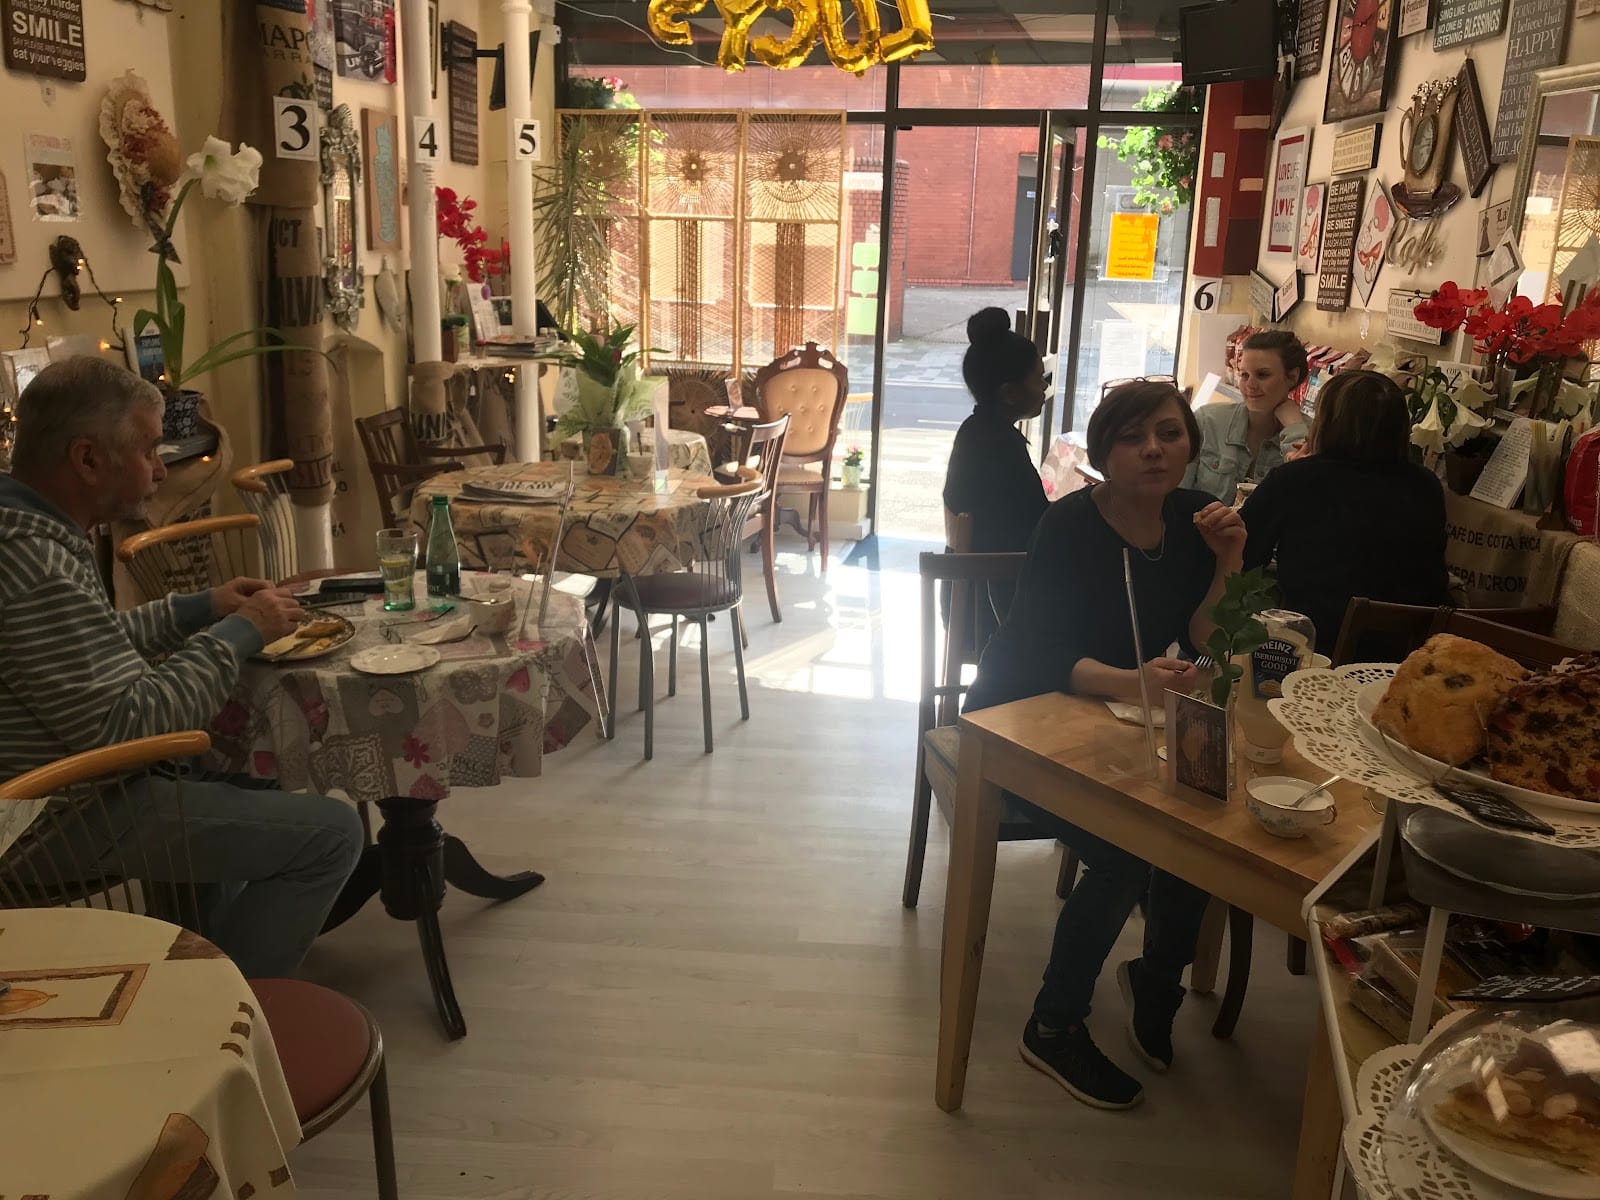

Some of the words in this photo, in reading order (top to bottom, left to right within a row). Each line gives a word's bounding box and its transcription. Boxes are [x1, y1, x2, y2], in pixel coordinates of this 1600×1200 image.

[1439, 8, 1453, 21] SING
[1454, 4, 1466, 17] LIKE
[12, 10, 82, 47] SMILE
[1463, 8, 1501, 39] BLESSINGS
[1297, 38, 1320, 56] SMILE
[1433, 30, 1464, 48] LISTENING
[1508, 27, 1561, 59] HAPPY
[13, 48, 28, 60] eat
[280, 105, 310, 151] 3
[418, 122, 438, 157] 4
[519, 124, 536, 155] 5
[1330, 185, 1339, 196] BE
[1339, 180, 1360, 195] HAPPY
[1327, 220, 1335, 230] BE
[1334, 218, 1355, 229] SWEET
[1320, 274, 1347, 289] SMILE
[1194, 281, 1217, 311] 6
[1467, 531, 1483, 546] DE
[1261, 640, 1292, 654] HEINZ
[1261, 661, 1288, 672] GOOD
